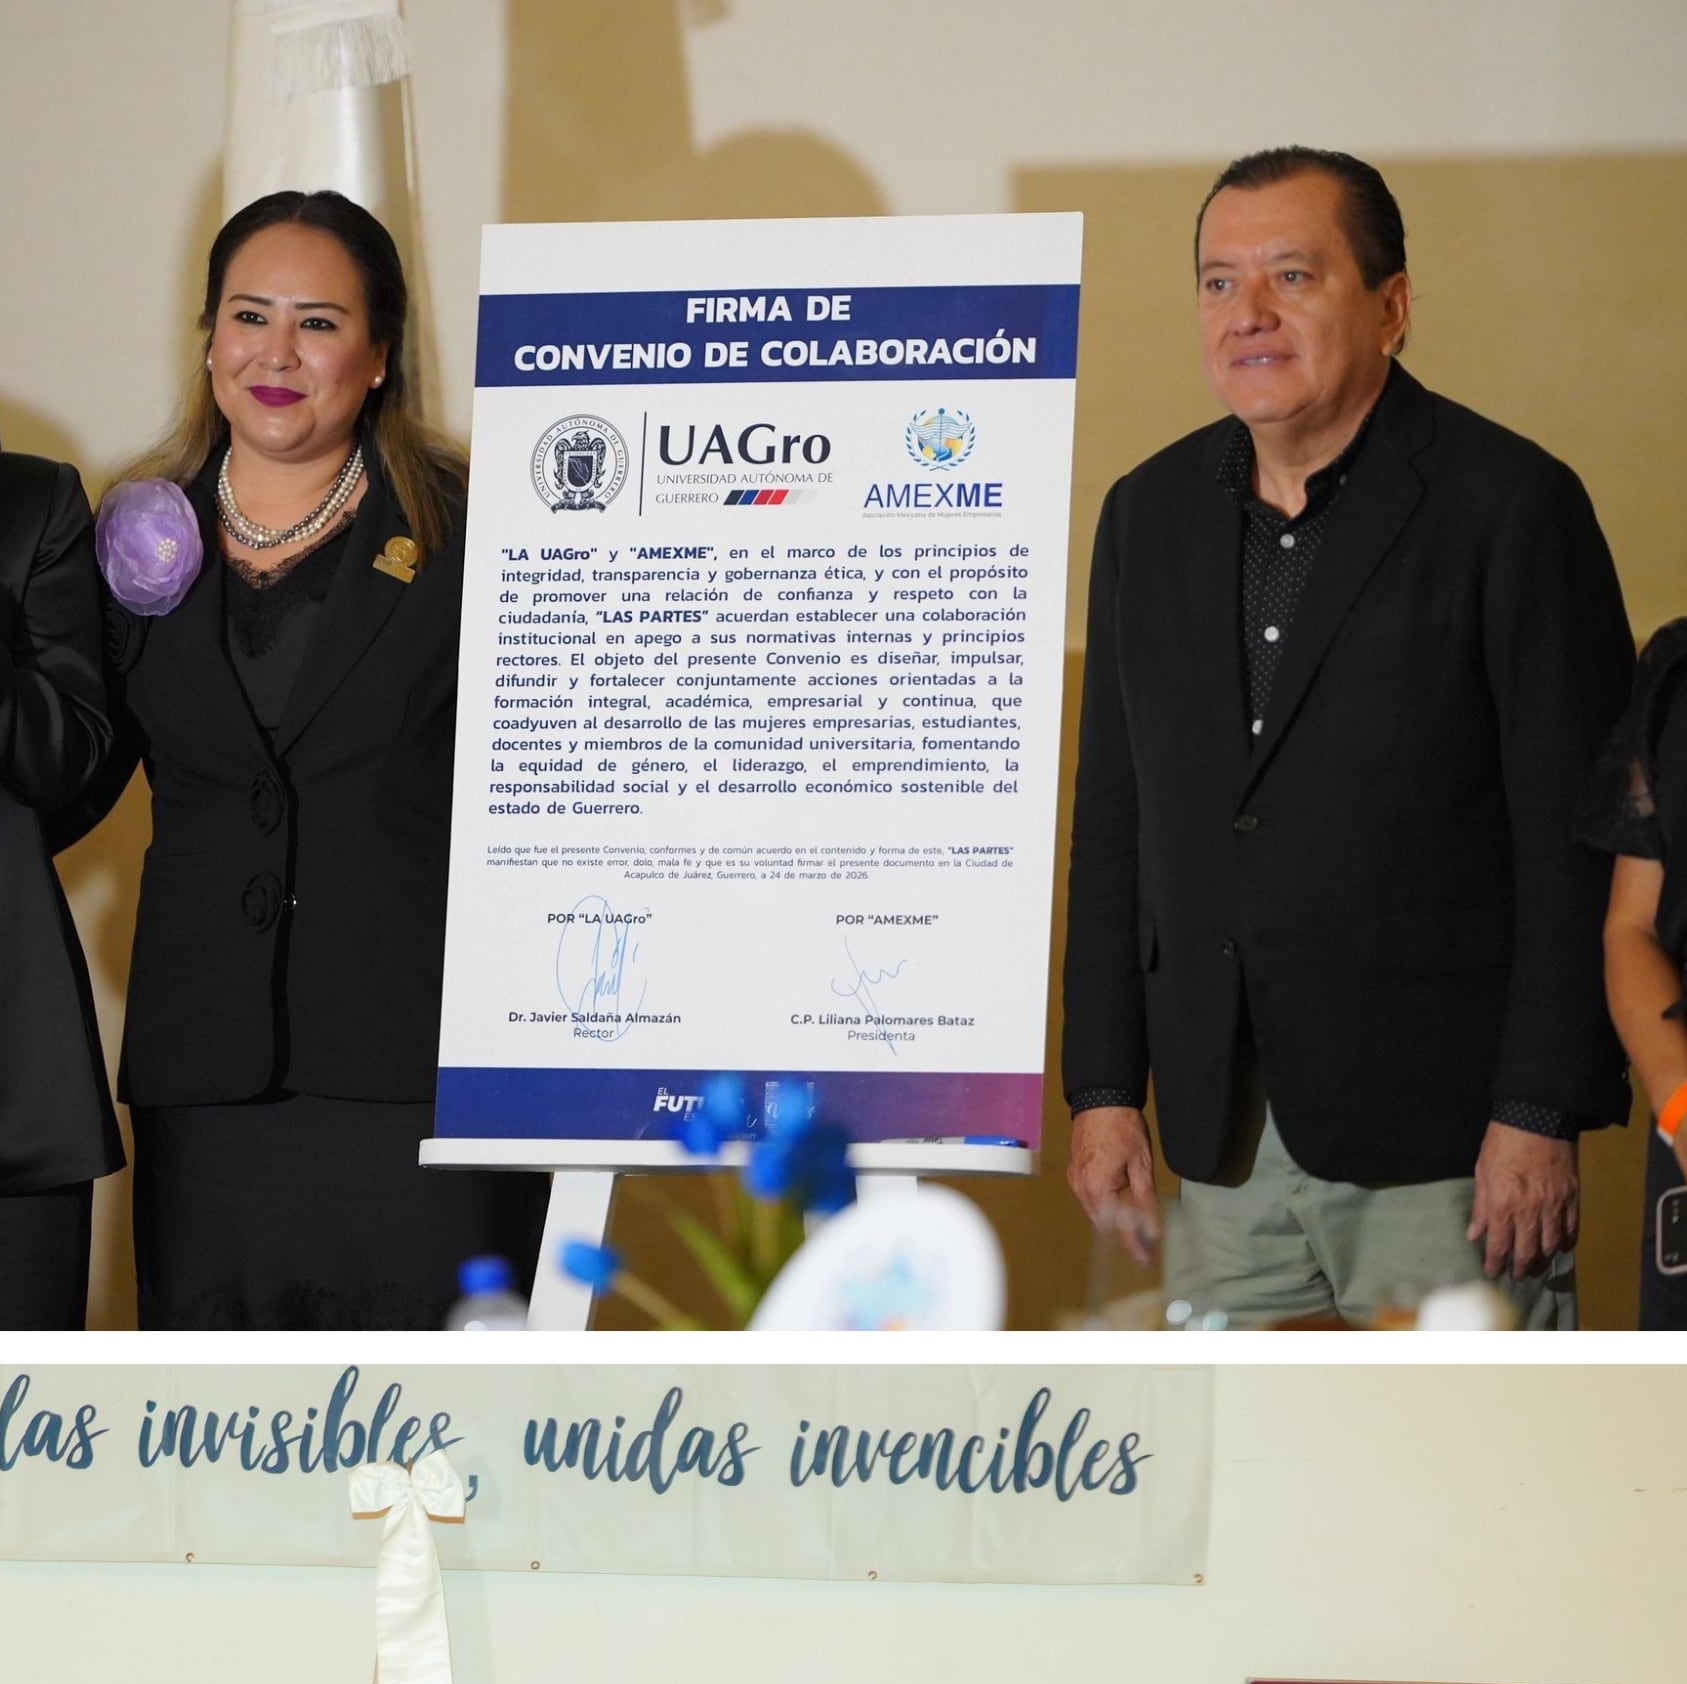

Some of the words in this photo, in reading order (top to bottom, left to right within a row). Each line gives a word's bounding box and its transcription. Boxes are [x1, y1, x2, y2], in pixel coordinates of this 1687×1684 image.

[686, 295, 791, 323] FIRMA
[807, 294, 851, 322] DE
[514, 341, 692, 372] CONVENIO
[704, 340, 747, 368] DE
[760, 328, 1037, 367] COLABORACIÓN
[658, 422, 832, 465] UAGro
[656, 473, 737, 485] UNIVERSIDAD
[740, 470, 814, 483] AUTÓNOMA
[818, 472, 834, 483] DE
[655, 493, 719, 504] GUERRERO
[863, 482, 1003, 508] AMEXME
[609, 550, 618, 563] y
[729, 549, 748, 559] en
[761, 546, 775, 558] el
[787, 548, 835, 558] marco
[848, 545, 867, 558] de
[880, 544, 902, 558] los
[914, 544, 996, 561] principios
[1010, 544, 1029, 557] de
[501, 568, 584, 585] integridad,
[592, 568, 700, 584] transparencia
[708, 570, 717, 583] y
[725, 567, 816, 583] gobernanza
[824, 566, 866, 581] ética,
[874, 570, 884, 582] y
[892, 569, 920, 579] con
[928, 566, 942, 578] el
[950, 565, 1028, 582] propósito
[498, 610, 588, 625] ciudadanía,
[716, 609, 788, 622] acuerdan
[796, 609, 878, 622] establecer
[886, 612, 915, 622] una
[922, 608, 1026, 621] colaboración
[498, 631, 596, 645] institucional
[606, 634, 624, 644] en
[634, 634, 682, 648] apego
[692, 634, 700, 644] a
[710, 634, 736, 644] sus
[746, 630, 836, 644] normativas
[847, 630, 912, 643] internas
[923, 633, 932, 646] y
[942, 629, 1025, 646] principios
[496, 654, 561, 666] rectores.
[571, 653, 585, 666] El
[594, 652, 644, 670] objeto
[654, 652, 678, 666] del
[688, 653, 756, 669] presente
[766, 652, 841, 665] Convenio
[850, 654, 868, 664] es
[878, 651, 940, 666] diseñar,
[951, 651, 1023, 668] impulsar,
[495, 674, 558, 687] difundir
[569, 677, 578, 690] y
[590, 673, 665, 687] fortalecer
[676, 673, 796, 690] conjuntamente
[808, 673, 878, 686] acciones
[890, 672, 976, 686] orientadas
[988, 676, 997, 685] a
[1009, 672, 1023, 685] la
[494, 694, 573, 708] formación
[588, 695, 650, 711] integral,
[665, 694, 752, 709] académica,
[768, 694, 862, 711] empresarial
[878, 698, 888, 710] y
[902, 694, 976, 708] continua,
[992, 697, 1022, 711] que
[493, 716, 577, 732] coadyuven
[583, 716, 597, 729] al
[604, 716, 682, 729] desarrollo
[688, 716, 708, 729] de
[714, 716, 736, 729] las
[742, 716, 806, 733] mujeres
[813, 716, 914, 732] empresarias,
[922, 715, 1020, 730] estudiantes,
[492, 738, 562, 751] docentes
[569, 741, 578, 754] y
[584, 737, 662, 750] miembros
[669, 737, 688, 750] de
[694, 737, 707, 750] la
[714, 737, 803, 750] comunidad
[810, 737, 915, 751] universitaria,
[922, 736, 1020, 750] fomentando
[490, 780, 615, 797] responsabilidad
[623, 780, 669, 793] social
[678, 784, 688, 796] y
[696, 780, 710, 793] el
[718, 780, 797, 793] desarrollo
[805, 779, 892, 793] económico
[901, 780, 984, 793] sostenible
[993, 780, 1018, 793] del
[488, 801, 540, 814] estado
[547, 801, 566, 814] de
[572, 802, 642, 814] Guerrero.
[624, 870, 664, 880] Acapulco
[668, 871, 680, 879] de
[770, 871, 781, 879] 24
[784, 871, 796, 879] de
[830, 871, 842, 880] de
[547, 913, 575, 924] POR
[836, 914, 864, 925] POR
[508, 1012, 526, 1023] Dr.
[529, 1011, 568, 1023] Javier
[571, 1012, 622, 1023] Saldaña
[625, 1012, 681, 1024] Almazán
[790, 1014, 815, 1025] C.P.
[819, 1013, 860, 1025] Liliana
[865, 1014, 934, 1026] Palomares
[937, 1015, 975, 1026] Bataz
[573, 1028, 614, 1038] Rector
[848, 1030, 916, 1041] Presidenta
[653, 1096, 705, 1112] FUT
[524, 1386, 762, 1494] unidas
[790, 1386, 1154, 1502] invencibles
